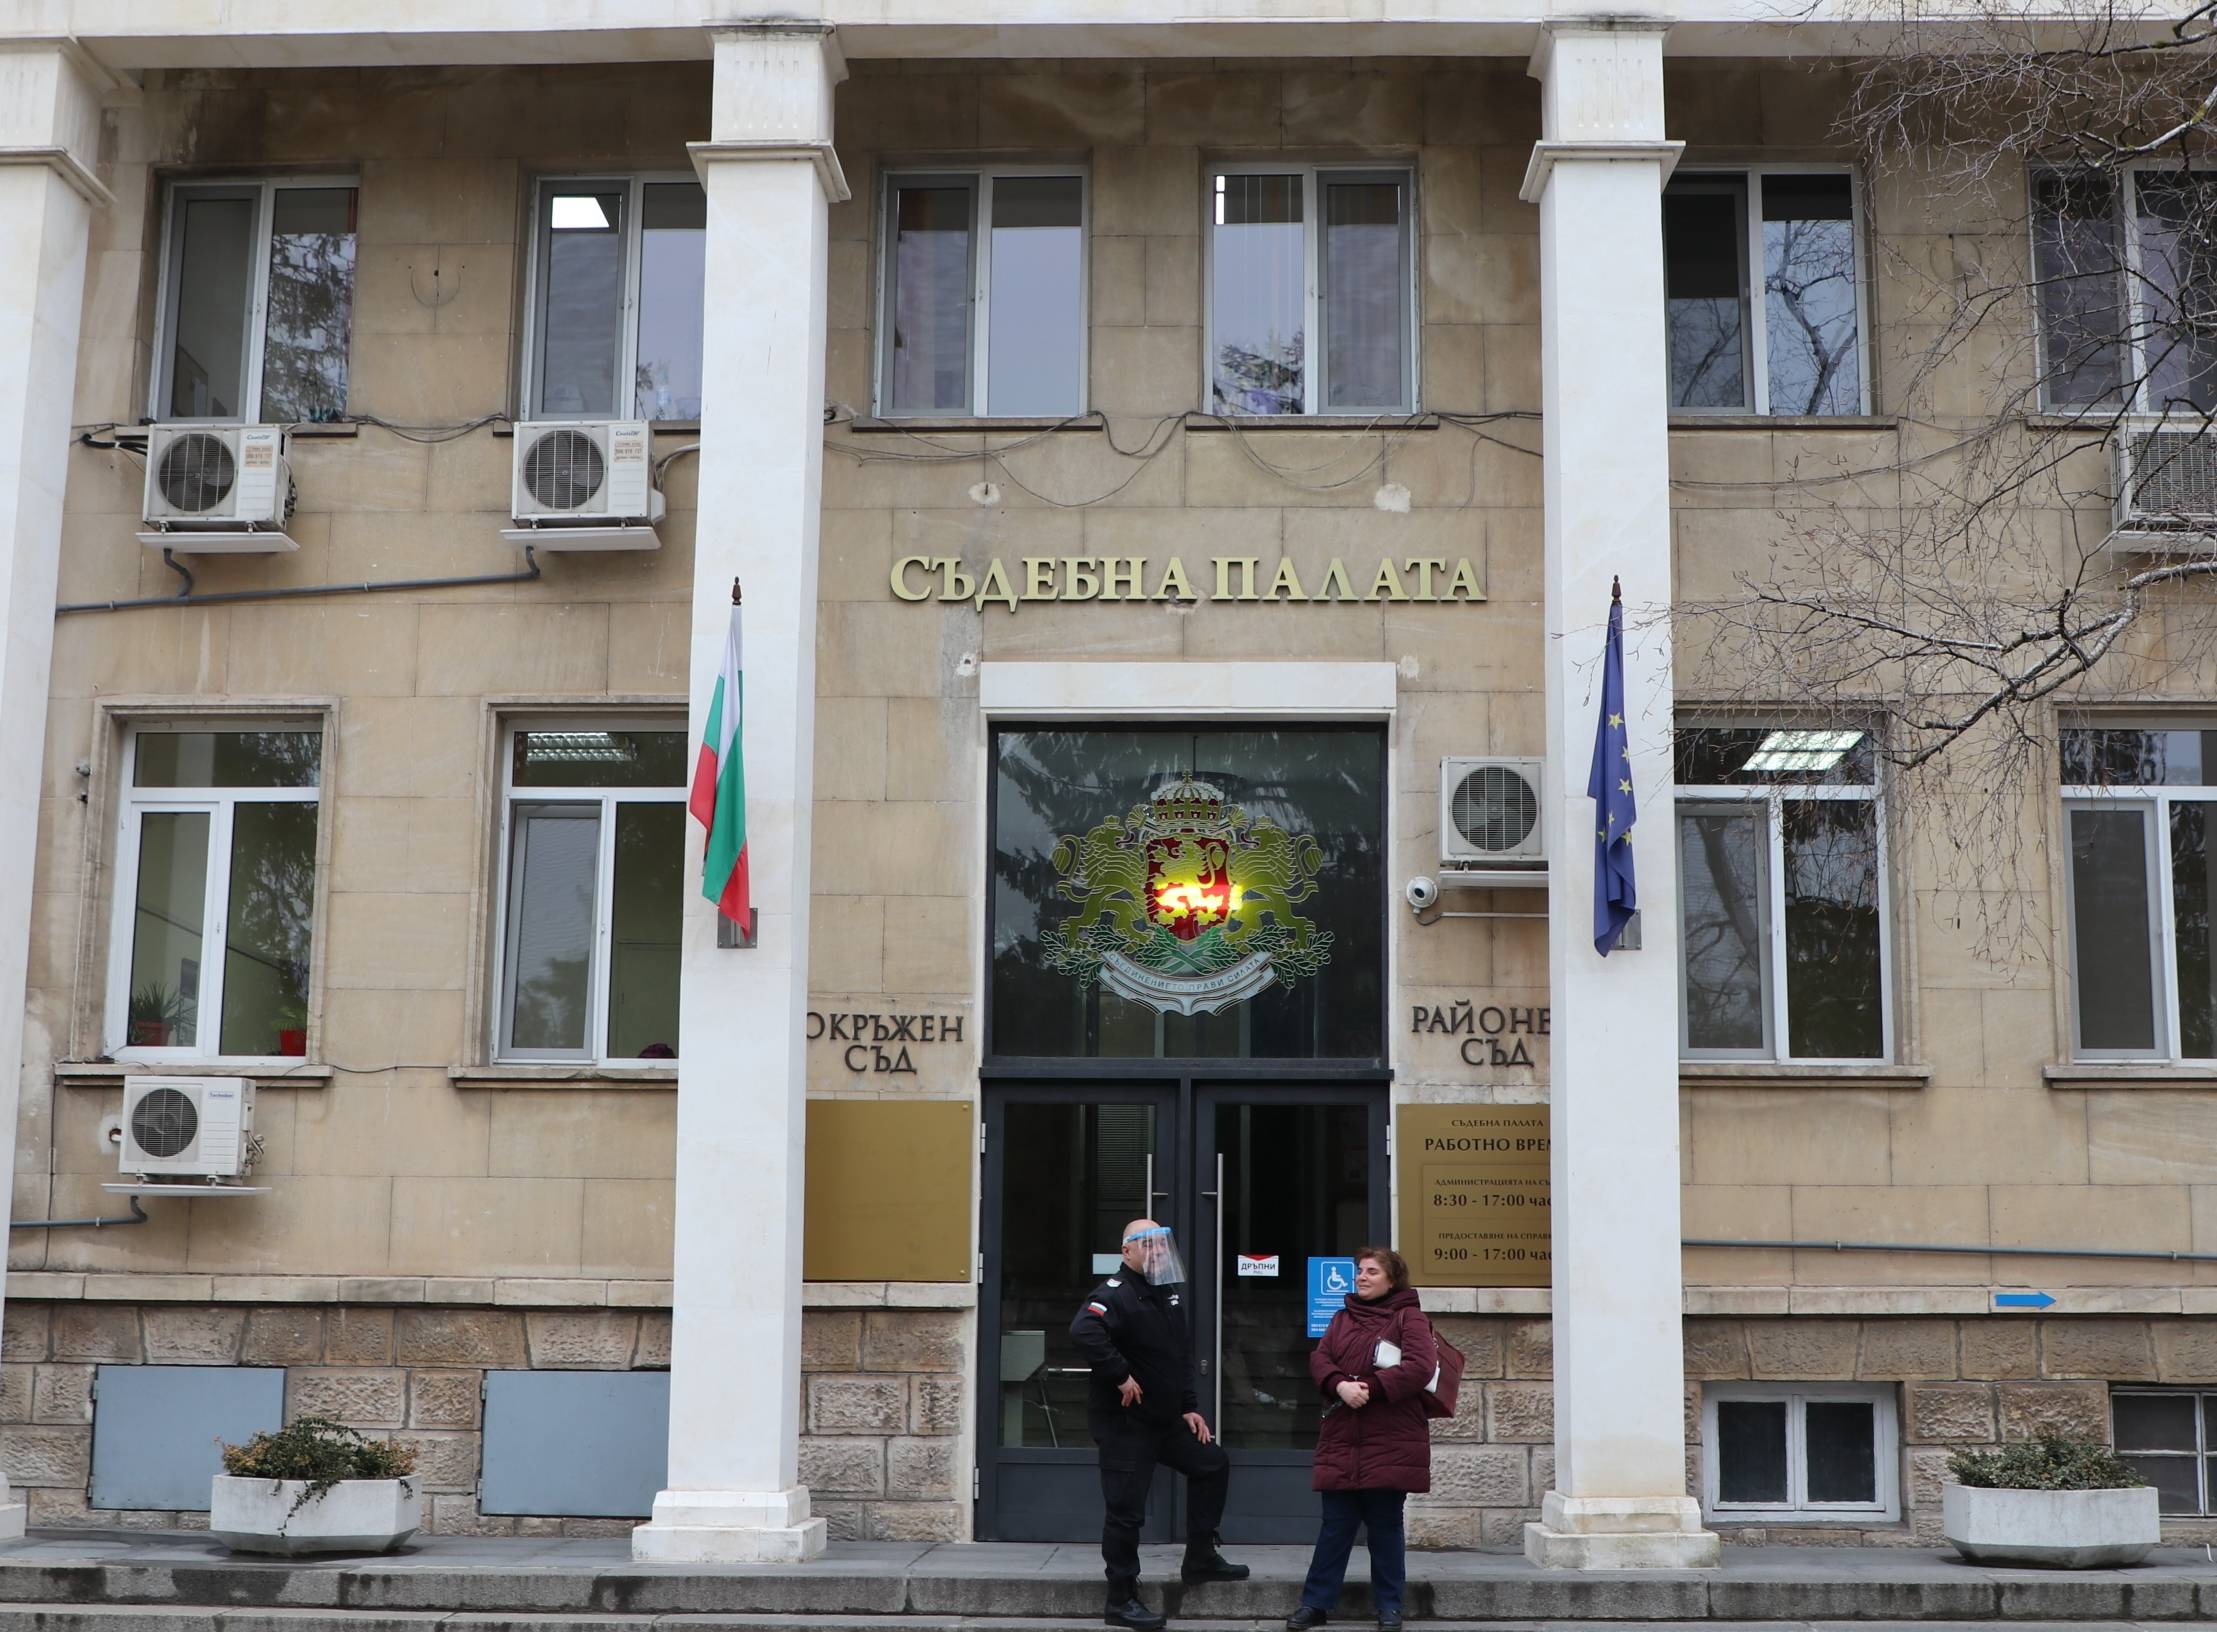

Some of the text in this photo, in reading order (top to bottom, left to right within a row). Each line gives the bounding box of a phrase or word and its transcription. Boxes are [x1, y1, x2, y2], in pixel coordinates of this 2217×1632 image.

[889, 555, 1488, 613] СЪДЕБНА ПАЛАТА
[1109, 953, 1260, 991] СЪЕДИНЕНИЕТО ПРАВИ СИЛАТА
[807, 1012, 964, 1042] ОКРЪЖЕН
[845, 1045, 917, 1075] СЪД
[1461, 1038, 1535, 1068] СЪД
[1451, 1119, 1544, 1128] СЪДЕБНА ПАЛАТА
[1425, 1138, 1510, 1151] РАБОТНО
[1433, 1194, 1467, 1207] 8:30
[1483, 1194, 1525, 1207] 17:00
[1434, 1248, 1468, 1260] 9:00
[1484, 1248, 1526, 1260] 17:00
[1241, 1263, 1276, 1271] ДРЪПНИ
